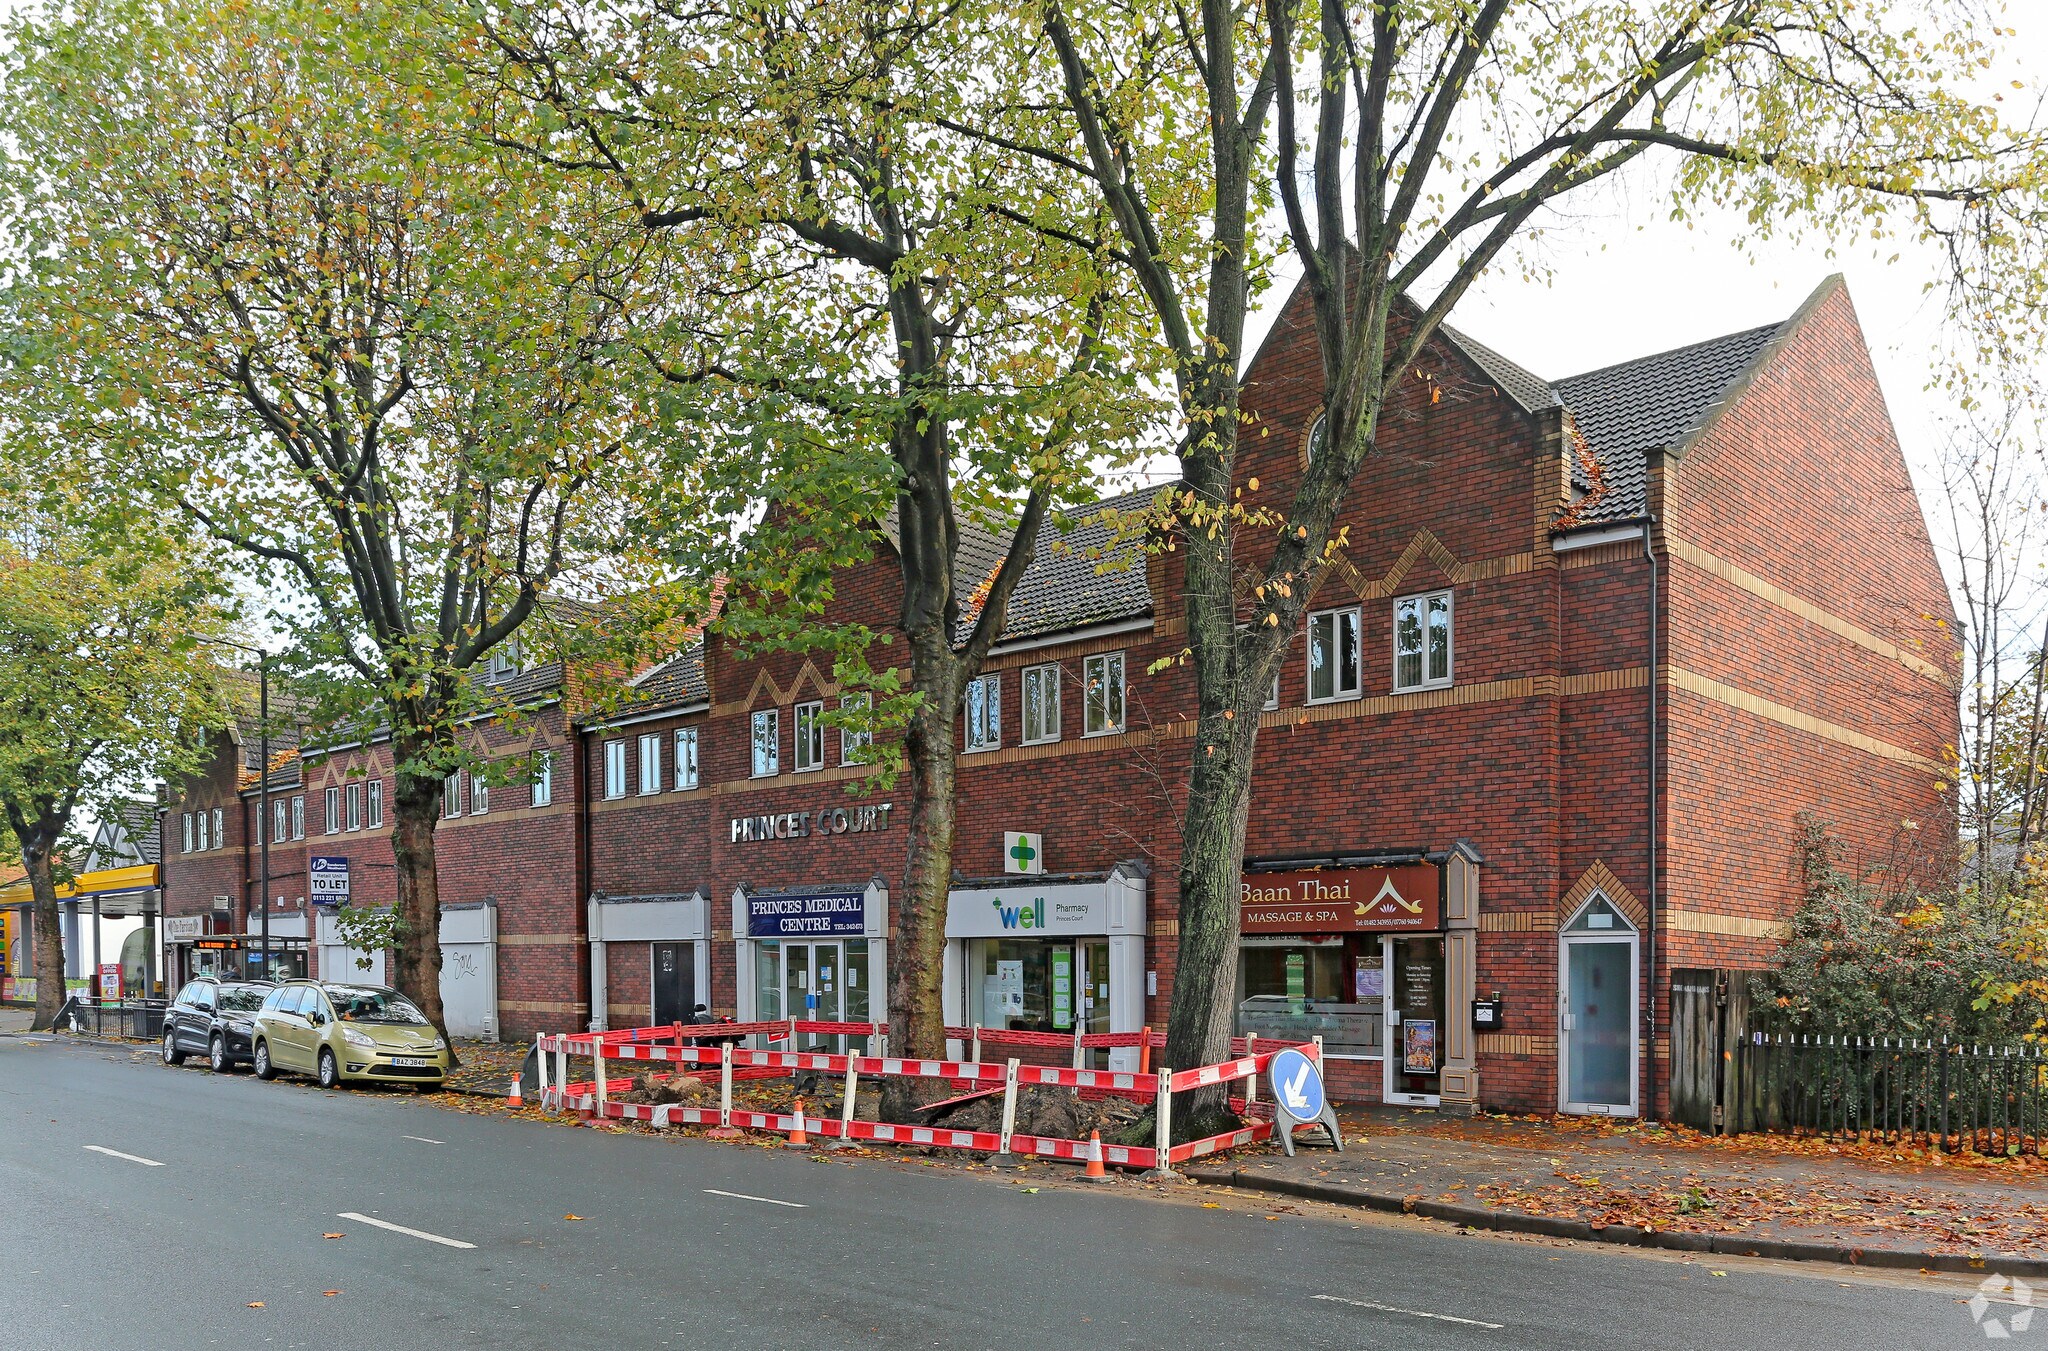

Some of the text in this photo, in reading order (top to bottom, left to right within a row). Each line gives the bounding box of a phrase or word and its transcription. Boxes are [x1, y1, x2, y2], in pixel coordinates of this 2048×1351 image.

[731, 803, 893, 843] PRINCES COURT
[312, 880, 347, 889] TO LET
[1240, 879, 1351, 902] Baan Thai
[751, 898, 861, 915] PRINCES MEDICAL
[999, 897, 1045, 929] well
[1056, 903, 1089, 914] Pharmacy
[779, 917, 831, 932] CENTRE
[1247, 911, 1339, 923] MASSAGE & SPA
